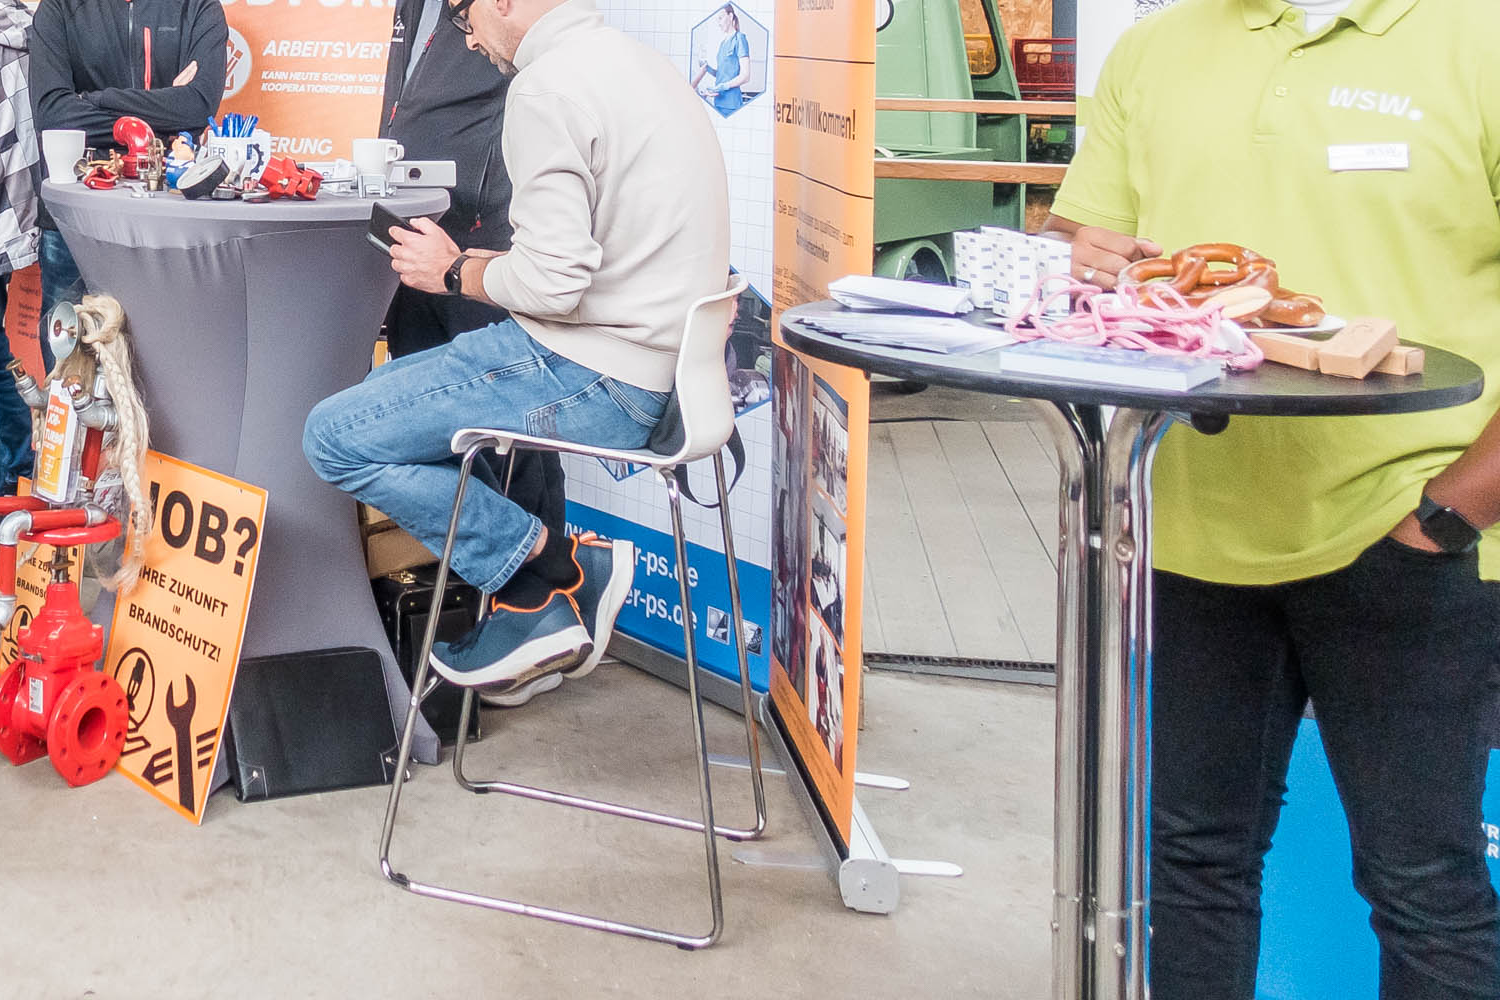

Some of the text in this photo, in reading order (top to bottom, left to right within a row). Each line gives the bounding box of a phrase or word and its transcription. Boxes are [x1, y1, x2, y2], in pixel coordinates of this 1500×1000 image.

[261, 70, 289, 80] KANN
[290, 71, 320, 81] HEUTE
[774, 96, 803, 126] erzlich
[139, 565, 229, 617] IHRE ZUKUNFT
[172, 604, 181, 615] IM
[129, 602, 222, 663] BRANDSCHUTZ!
